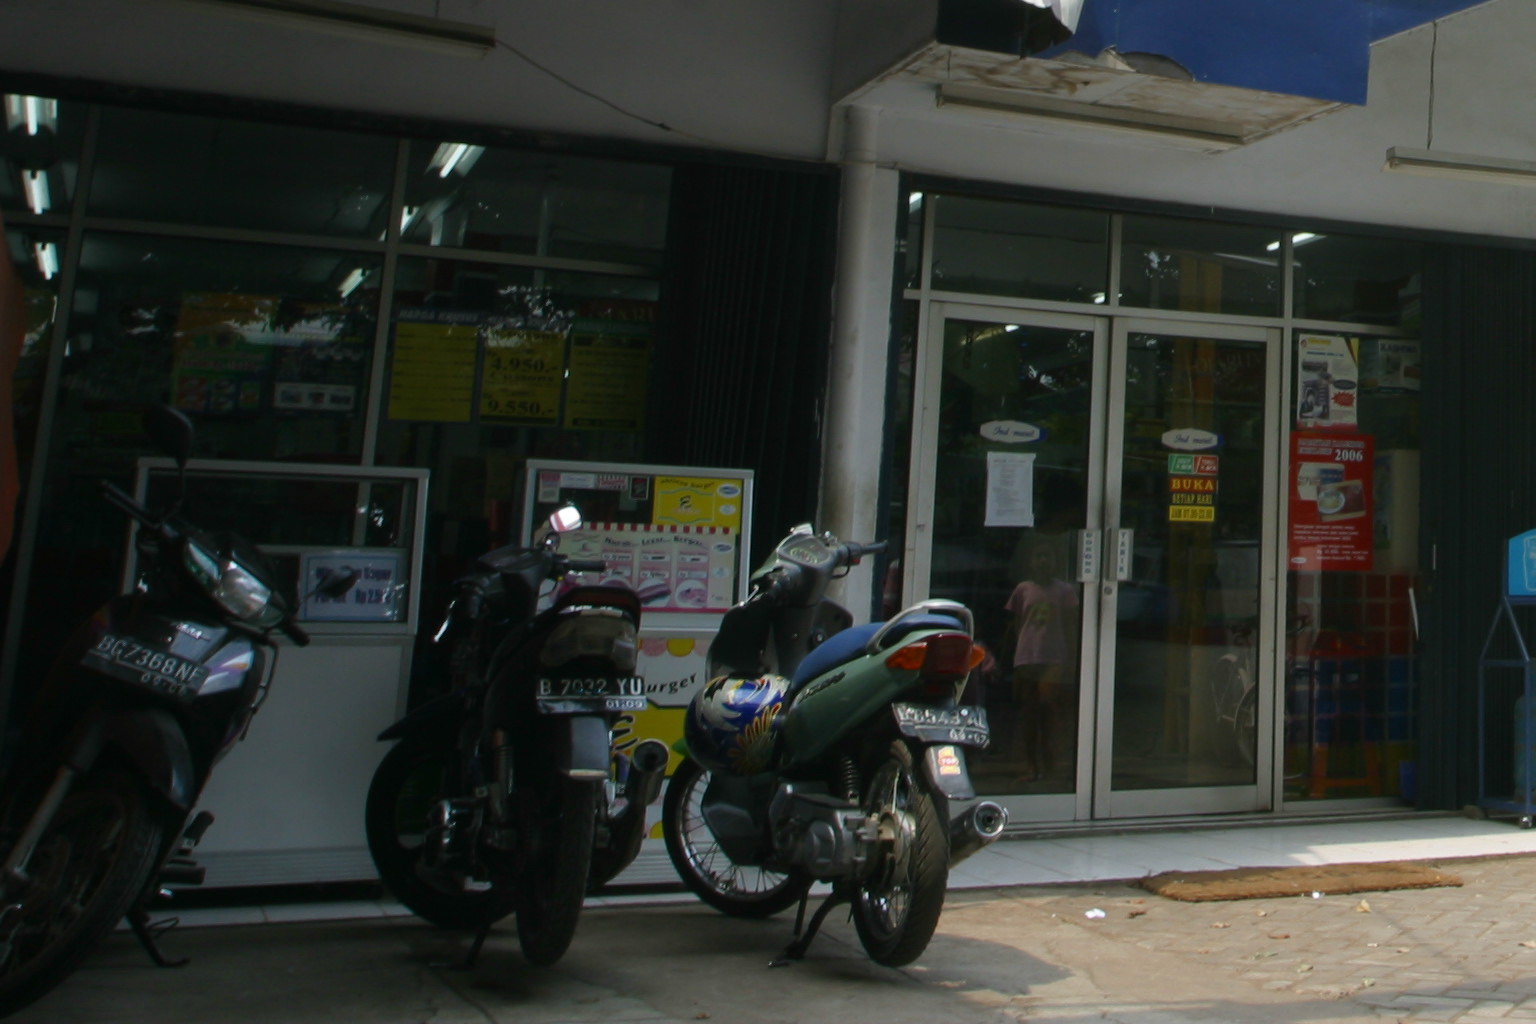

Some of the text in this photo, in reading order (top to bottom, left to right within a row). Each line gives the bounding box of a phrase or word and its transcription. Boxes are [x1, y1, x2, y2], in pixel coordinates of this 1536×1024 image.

[1335, 449, 1363, 462] 2006
[1171, 478, 1214, 491] BUKA
[1084, 532, 1093, 574] DORONG
[540, 679, 552, 696] B
[616, 678, 643, 696] YU
